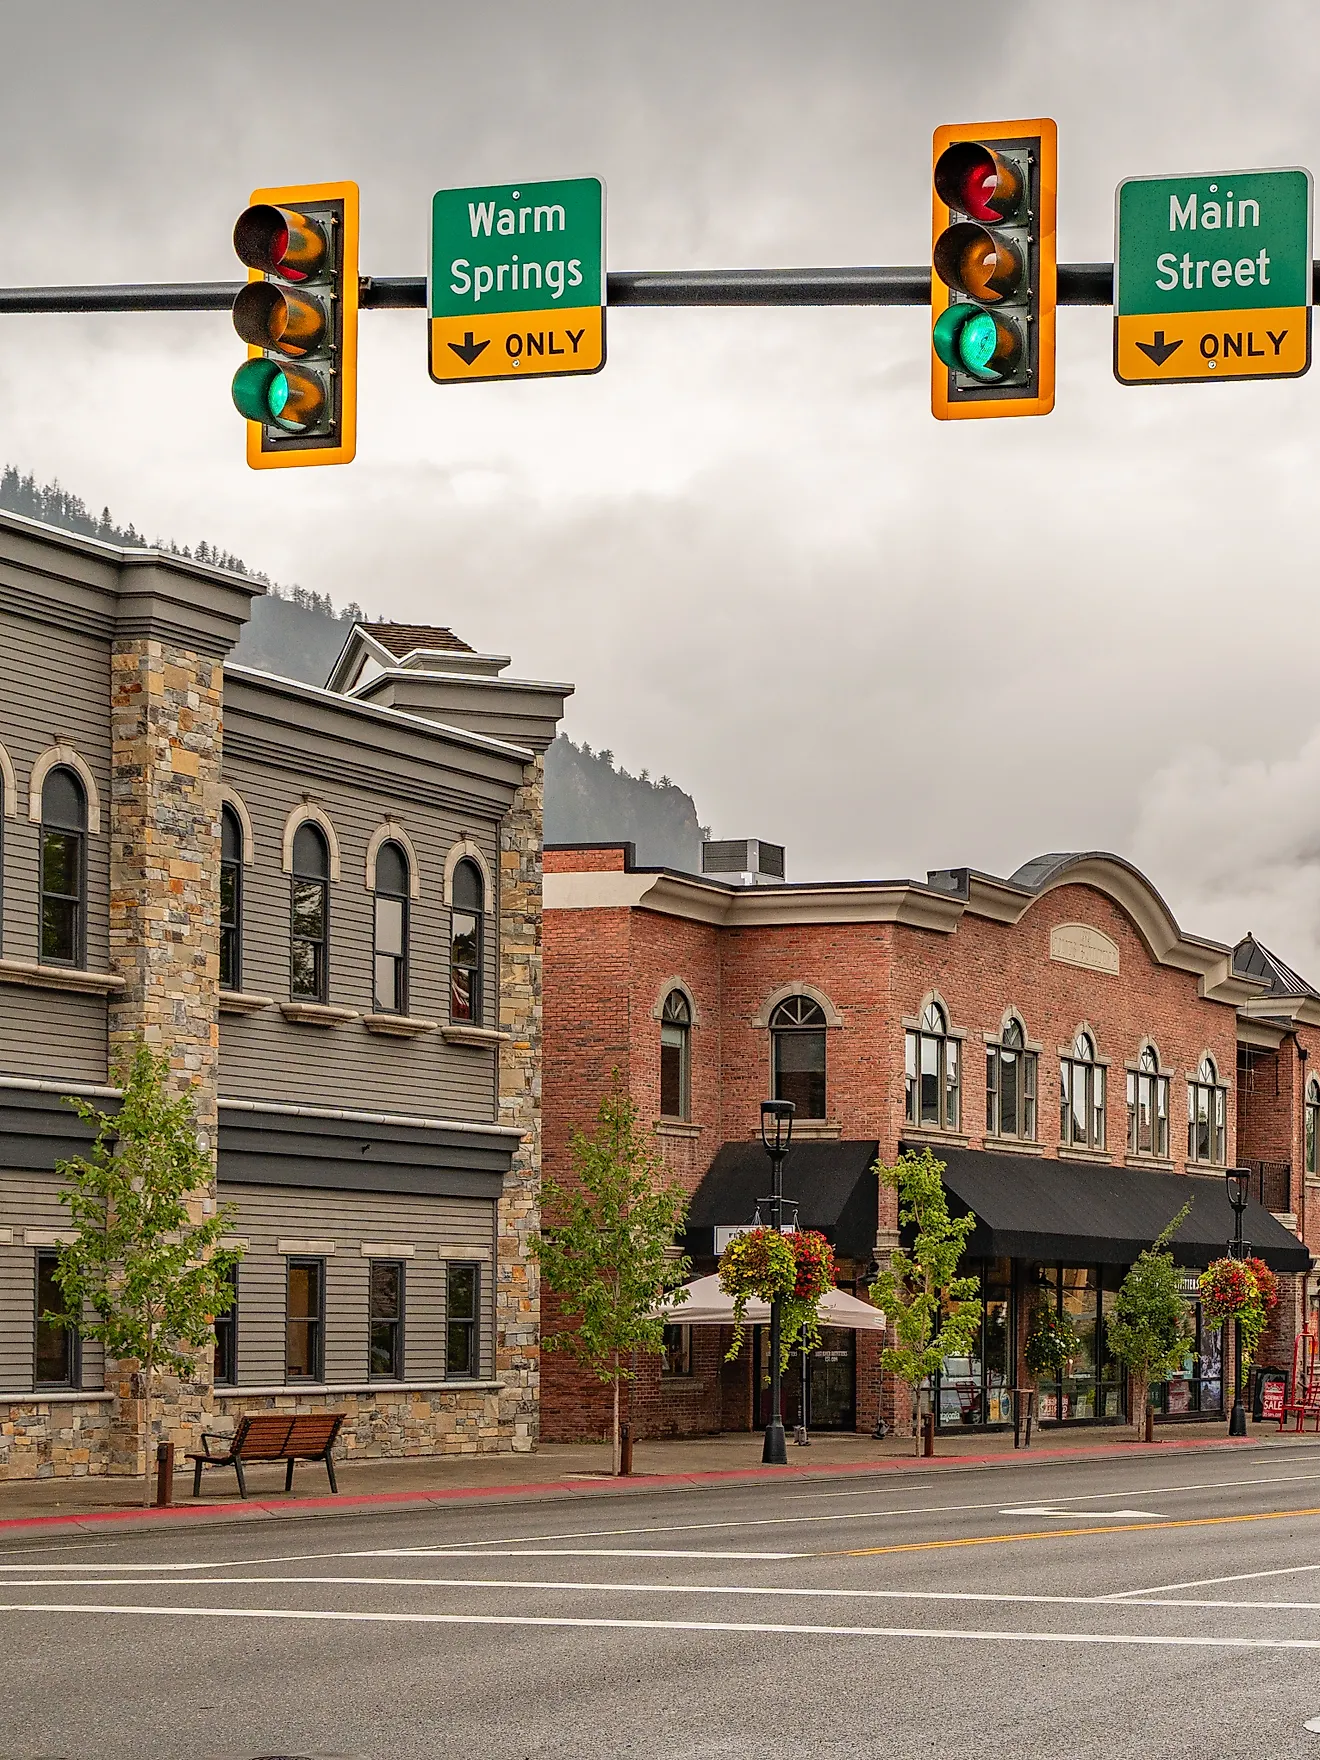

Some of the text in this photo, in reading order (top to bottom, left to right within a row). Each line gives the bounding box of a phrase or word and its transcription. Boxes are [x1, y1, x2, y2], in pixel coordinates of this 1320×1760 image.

[469, 202, 564, 237] Warm
[1170, 192, 1259, 231] Main
[450, 257, 582, 301] Springs
[1156, 248, 1270, 290] Street
[506, 329, 585, 357] ONLY
[1200, 330, 1288, 358] ONLY
[1264, 1400, 1283, 1410] SALE
